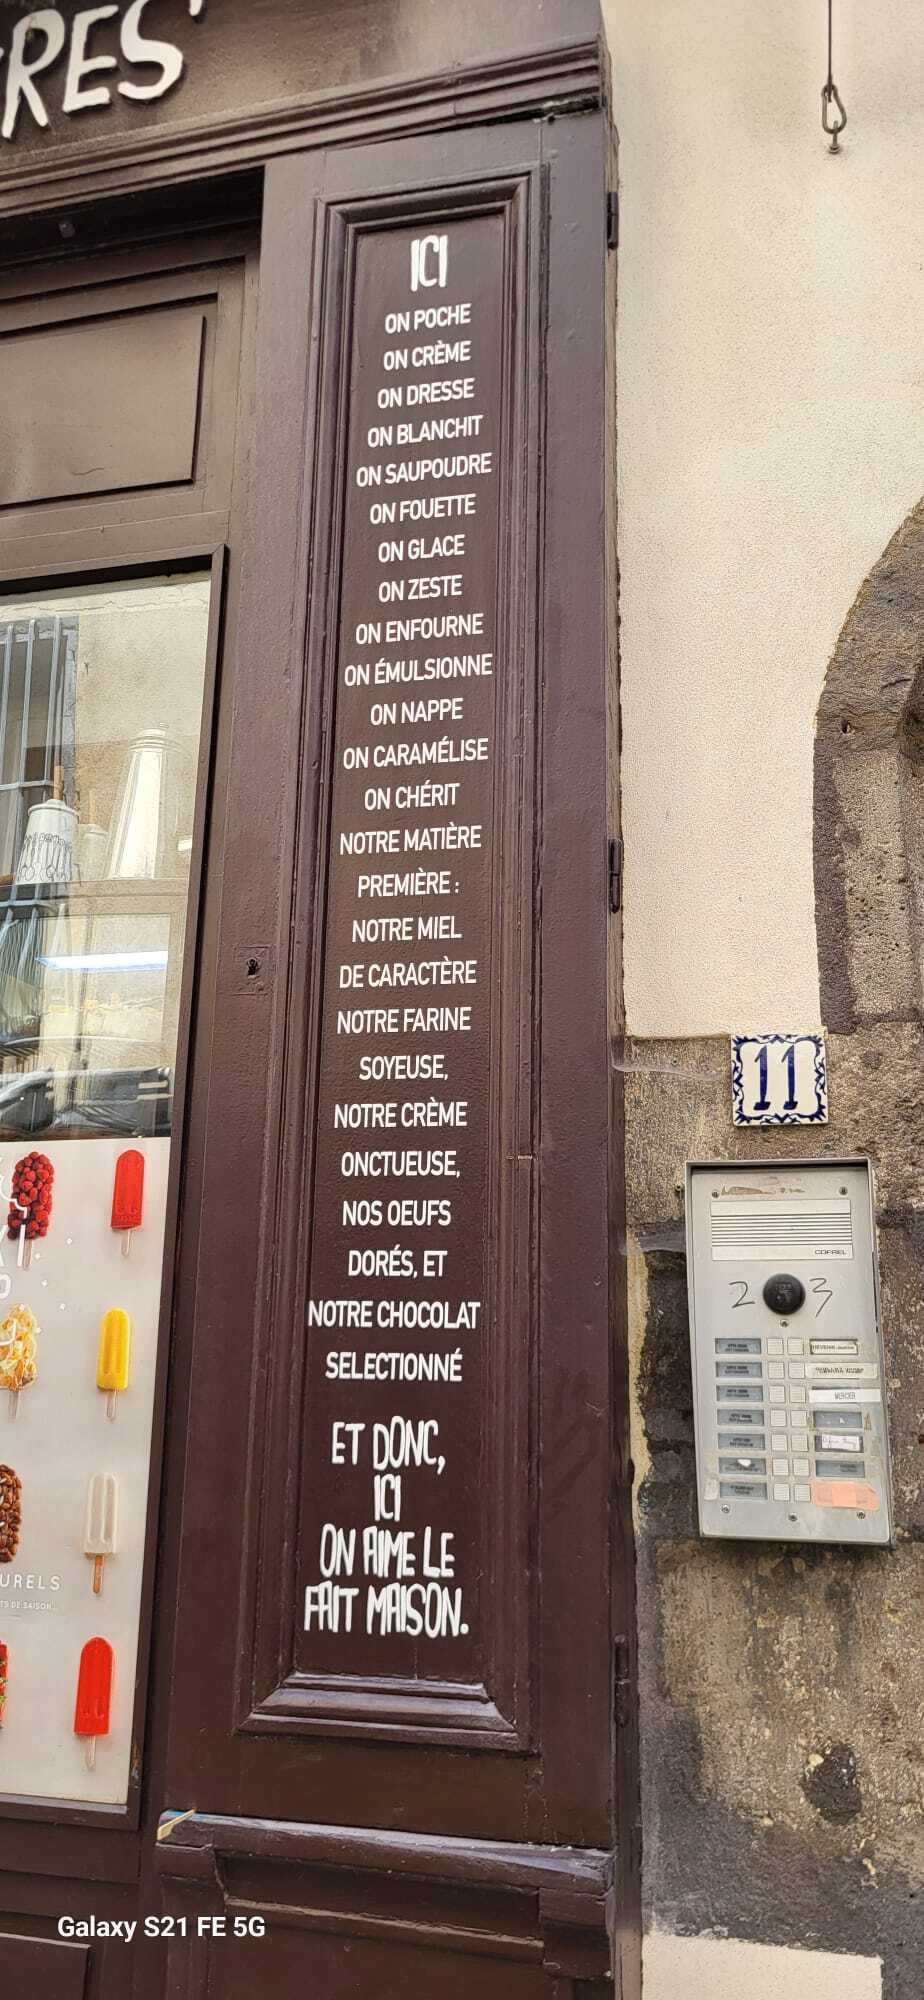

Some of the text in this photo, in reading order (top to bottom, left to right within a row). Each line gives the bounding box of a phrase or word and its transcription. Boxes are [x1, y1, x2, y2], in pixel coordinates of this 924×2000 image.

[410, 234, 450, 293] ICI
[384, 302, 473, 335] ON POCHE
[383, 339, 473, 371] ON CRÈME
[376, 377, 476, 409] ON DRESSE
[367, 414, 485, 449] ON BLANCHIT
[355, 451, 493, 488] ON SAUPOUDRE
[369, 492, 477, 525] ON FOUETTE
[377, 533, 466, 564] ON GLACE
[378, 573, 463, 603] ON ZESTE
[355, 612, 485, 645] ON ENFOURNE
[344, 652, 494, 687] ON ÉMULSIONNE
[370, 697, 464, 726] ON NAPPE
[342, 735, 489, 770] ON CARAMÉLISE
[364, 779, 461, 811] ON CHÉRIT
[339, 821, 483, 856] NOTRE MATIÈRE
[357, 866, 452, 899] PREMIÈRE
[351, 915, 463, 943] NOTRE MIEL
[339, 955, 478, 989] DE CARACTÈRE
[336, 1006, 473, 1035] NOTRE FARINE
[358, 1054, 449, 1081] SOYEUSE,
[754, 1044, 799, 1111] 11
[333, 1096, 468, 1129] NOTRE CRÈME
[341, 1150, 461, 1179] ONCTUEUSE,
[342, 1199, 452, 1226] NOS OEUFS
[348, 1243, 448, 1279] DORÉS, ET
[729, 1281, 755, 1309] 2
[308, 1300, 481, 1329] NOTRE CHOCOLAT
[325, 1347, 463, 1382] SELECTIONNÉ
[331, 1415, 446, 1475] ET DONC,
[373, 1473, 402, 1522] ICI
[319, 1523, 455, 1579] ON AIME LE
[303, 1580, 469, 1639] FAIT MAISON.
